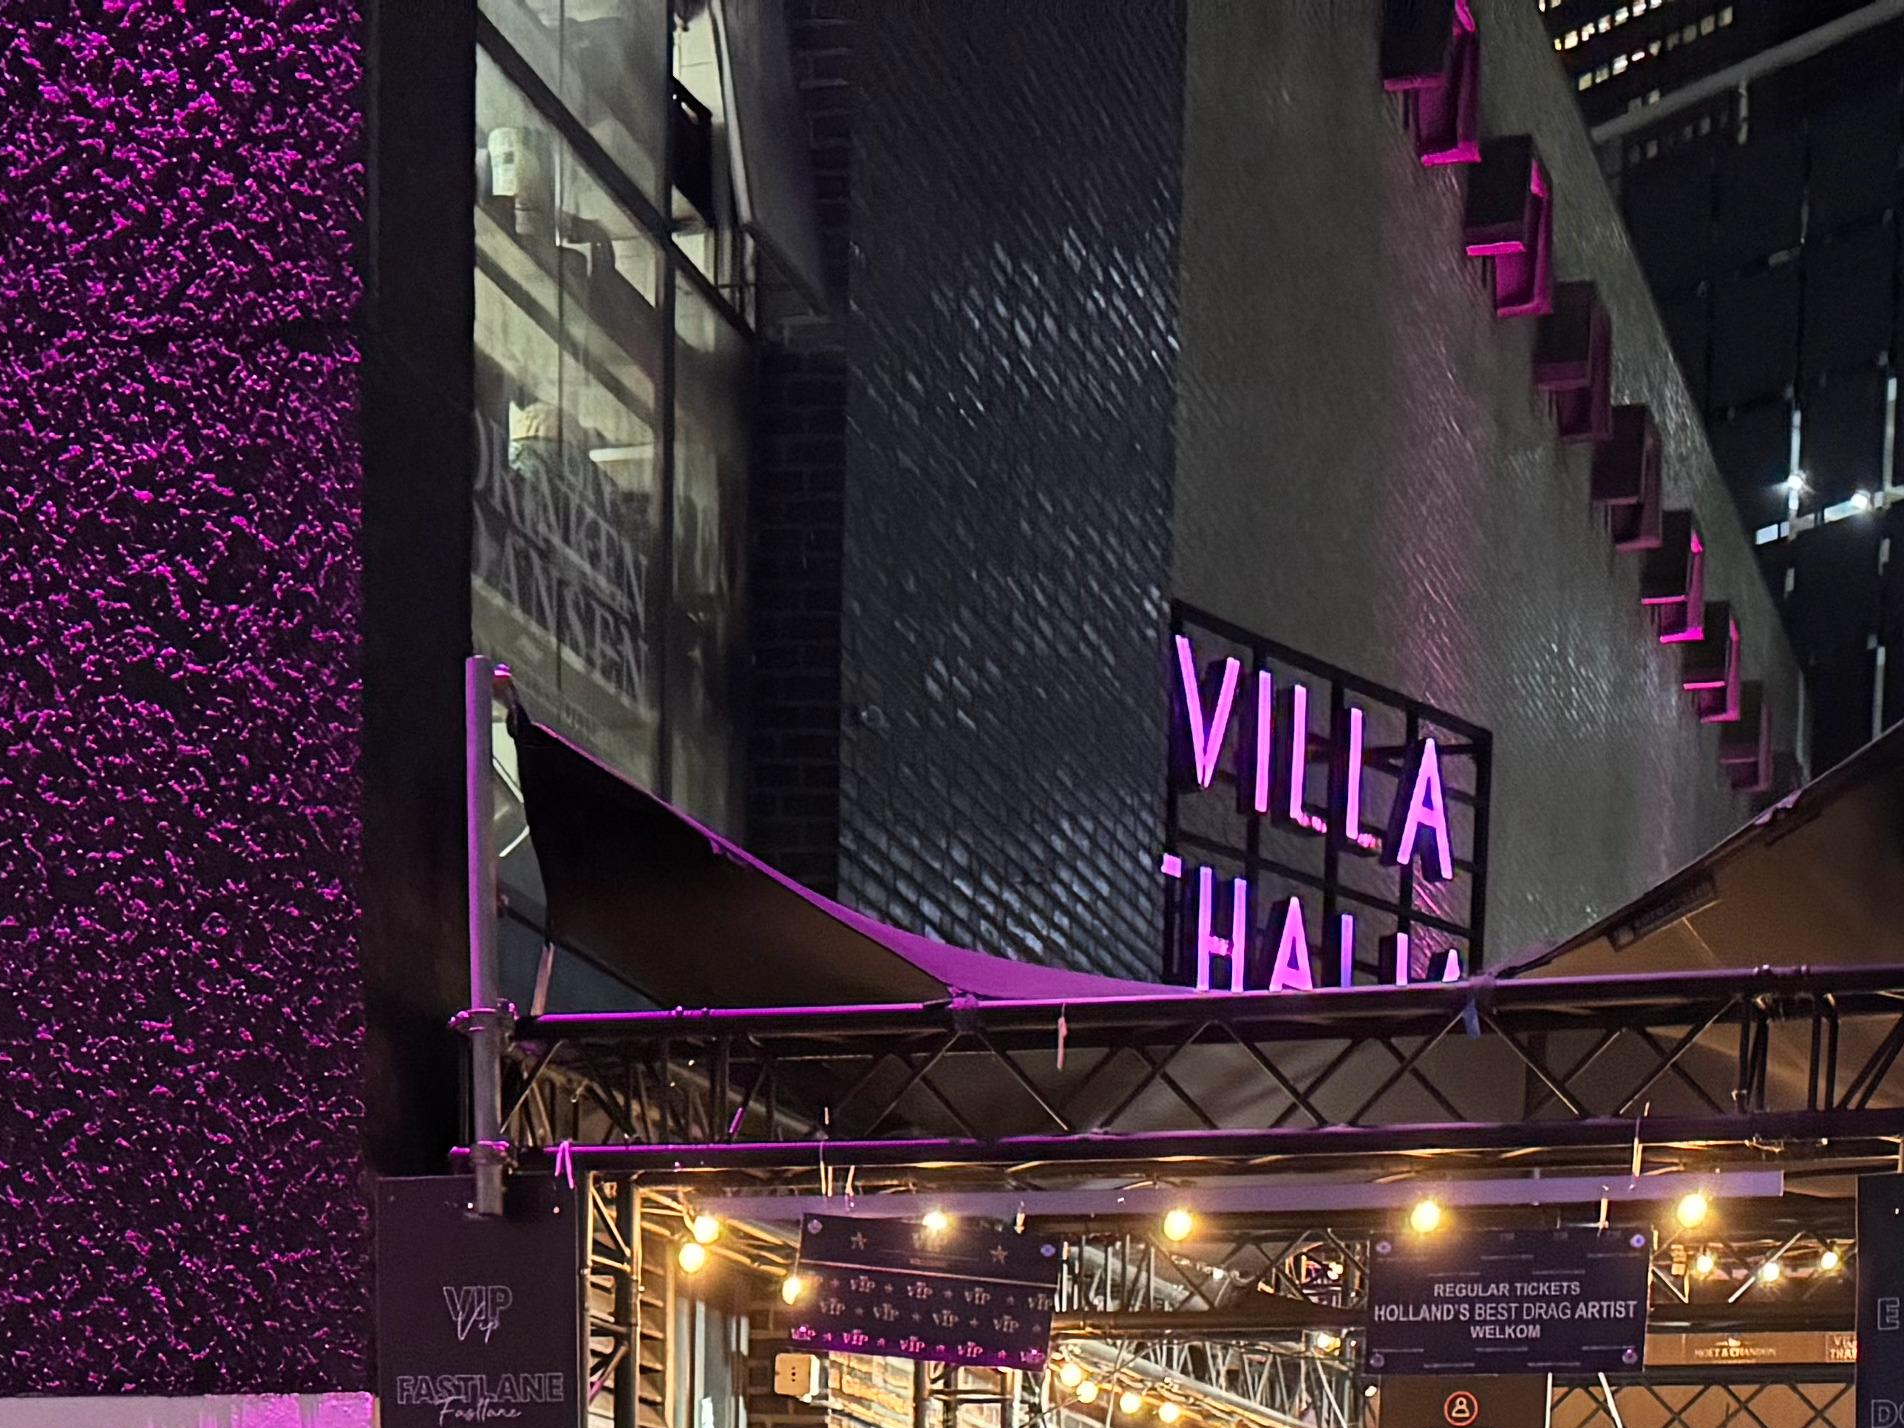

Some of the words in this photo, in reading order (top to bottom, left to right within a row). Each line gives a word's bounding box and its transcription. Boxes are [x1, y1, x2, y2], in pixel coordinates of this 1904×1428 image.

[1175, 634, 1454, 881] VILLA
[443, 1286, 512, 1321] VIP
[1434, 1282, 1510, 1298] REGULAR
[1515, 1281, 1581, 1296] TICKETS
[1374, 1304, 1470, 1322] HOLLAND'S
[1475, 1302, 1519, 1321] BEST
[1523, 1302, 1571, 1320] DRAG
[1575, 1300, 1638, 1319] ARTIST
[1877, 1296, 1900, 1331] E
[1470, 1324, 1541, 1339] WELKOM
[397, 1373, 564, 1404] FASTLANE
